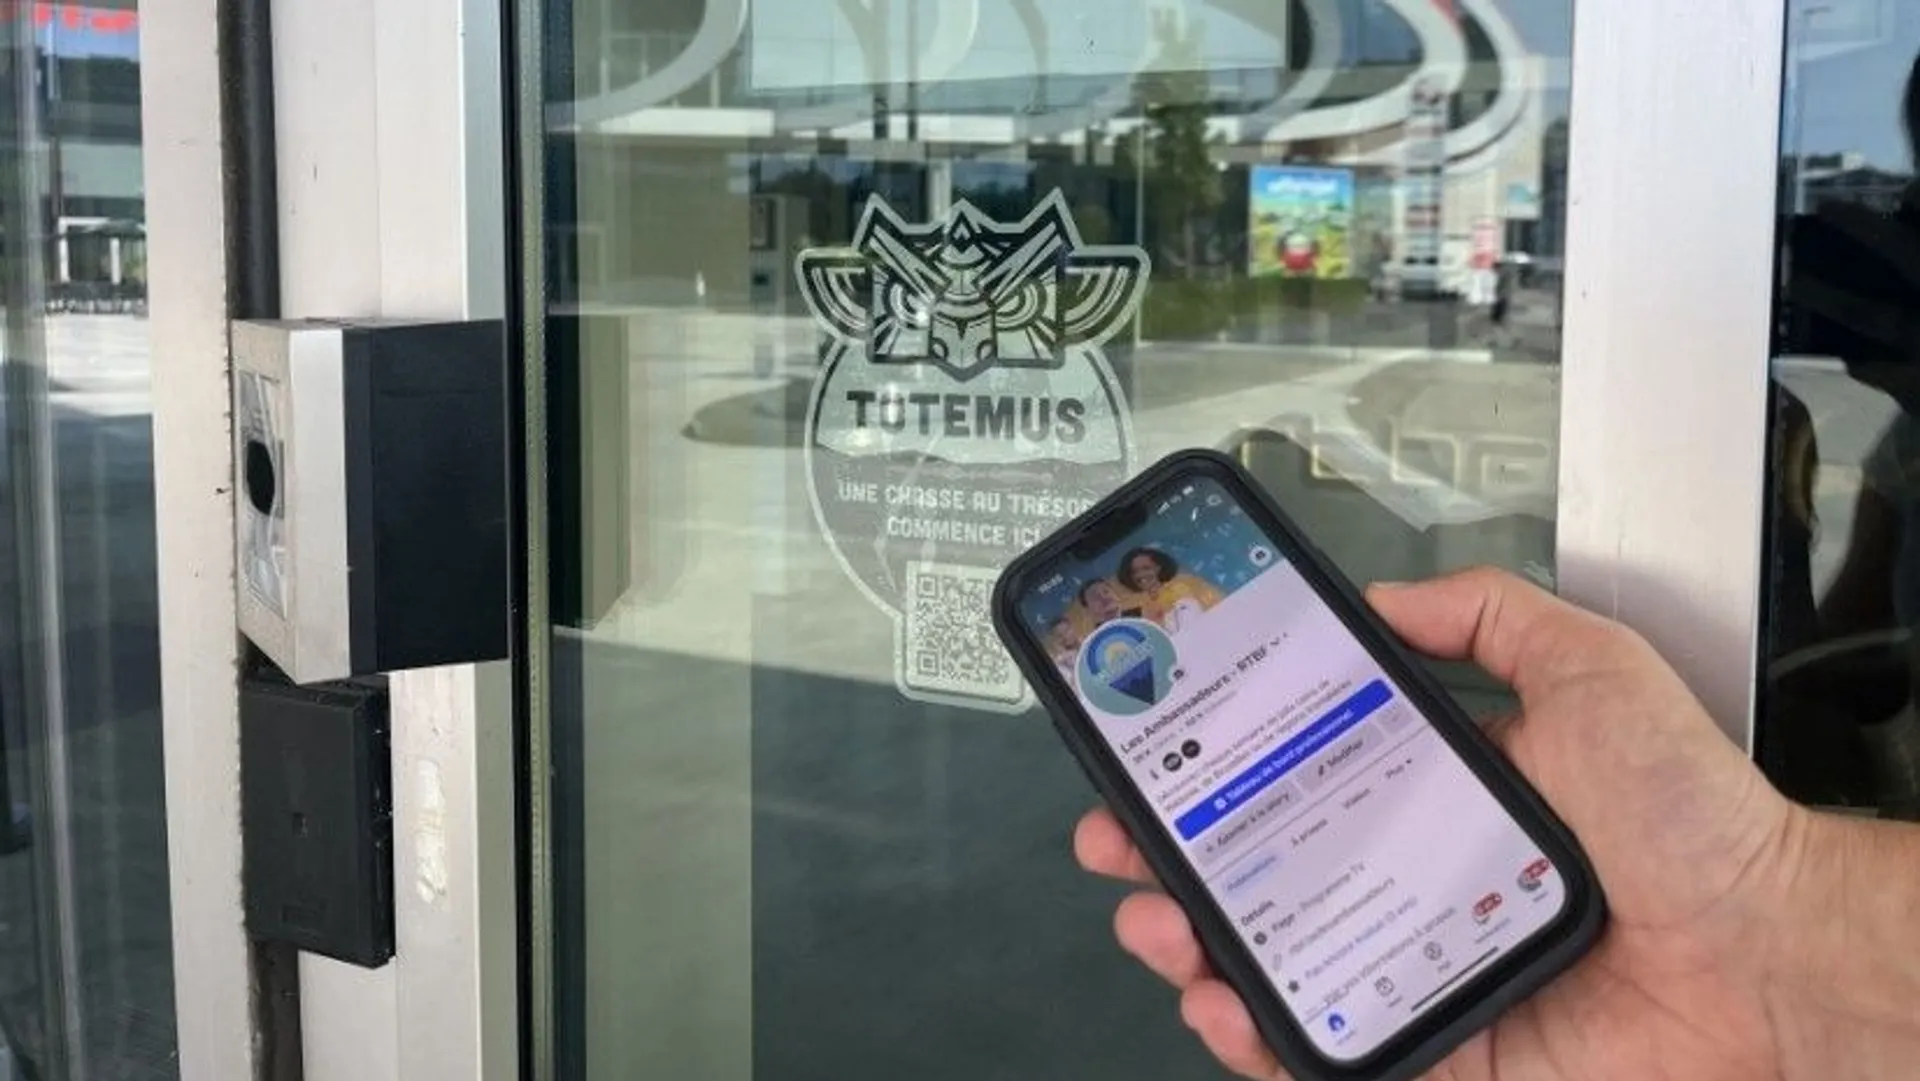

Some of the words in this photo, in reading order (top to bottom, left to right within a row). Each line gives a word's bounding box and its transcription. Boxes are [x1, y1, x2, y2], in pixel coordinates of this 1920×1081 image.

[846, 390, 1086, 444] TOTEMUS
[838, 482, 879, 502] UNE
[885, 484, 966, 511] CHASSE
[973, 490, 1001, 513] AU
[887, 516, 1006, 545] COMMENCE
[1120, 733, 1145, 753] Les
[1142, 672, 1230, 738] Ambassadeurs
